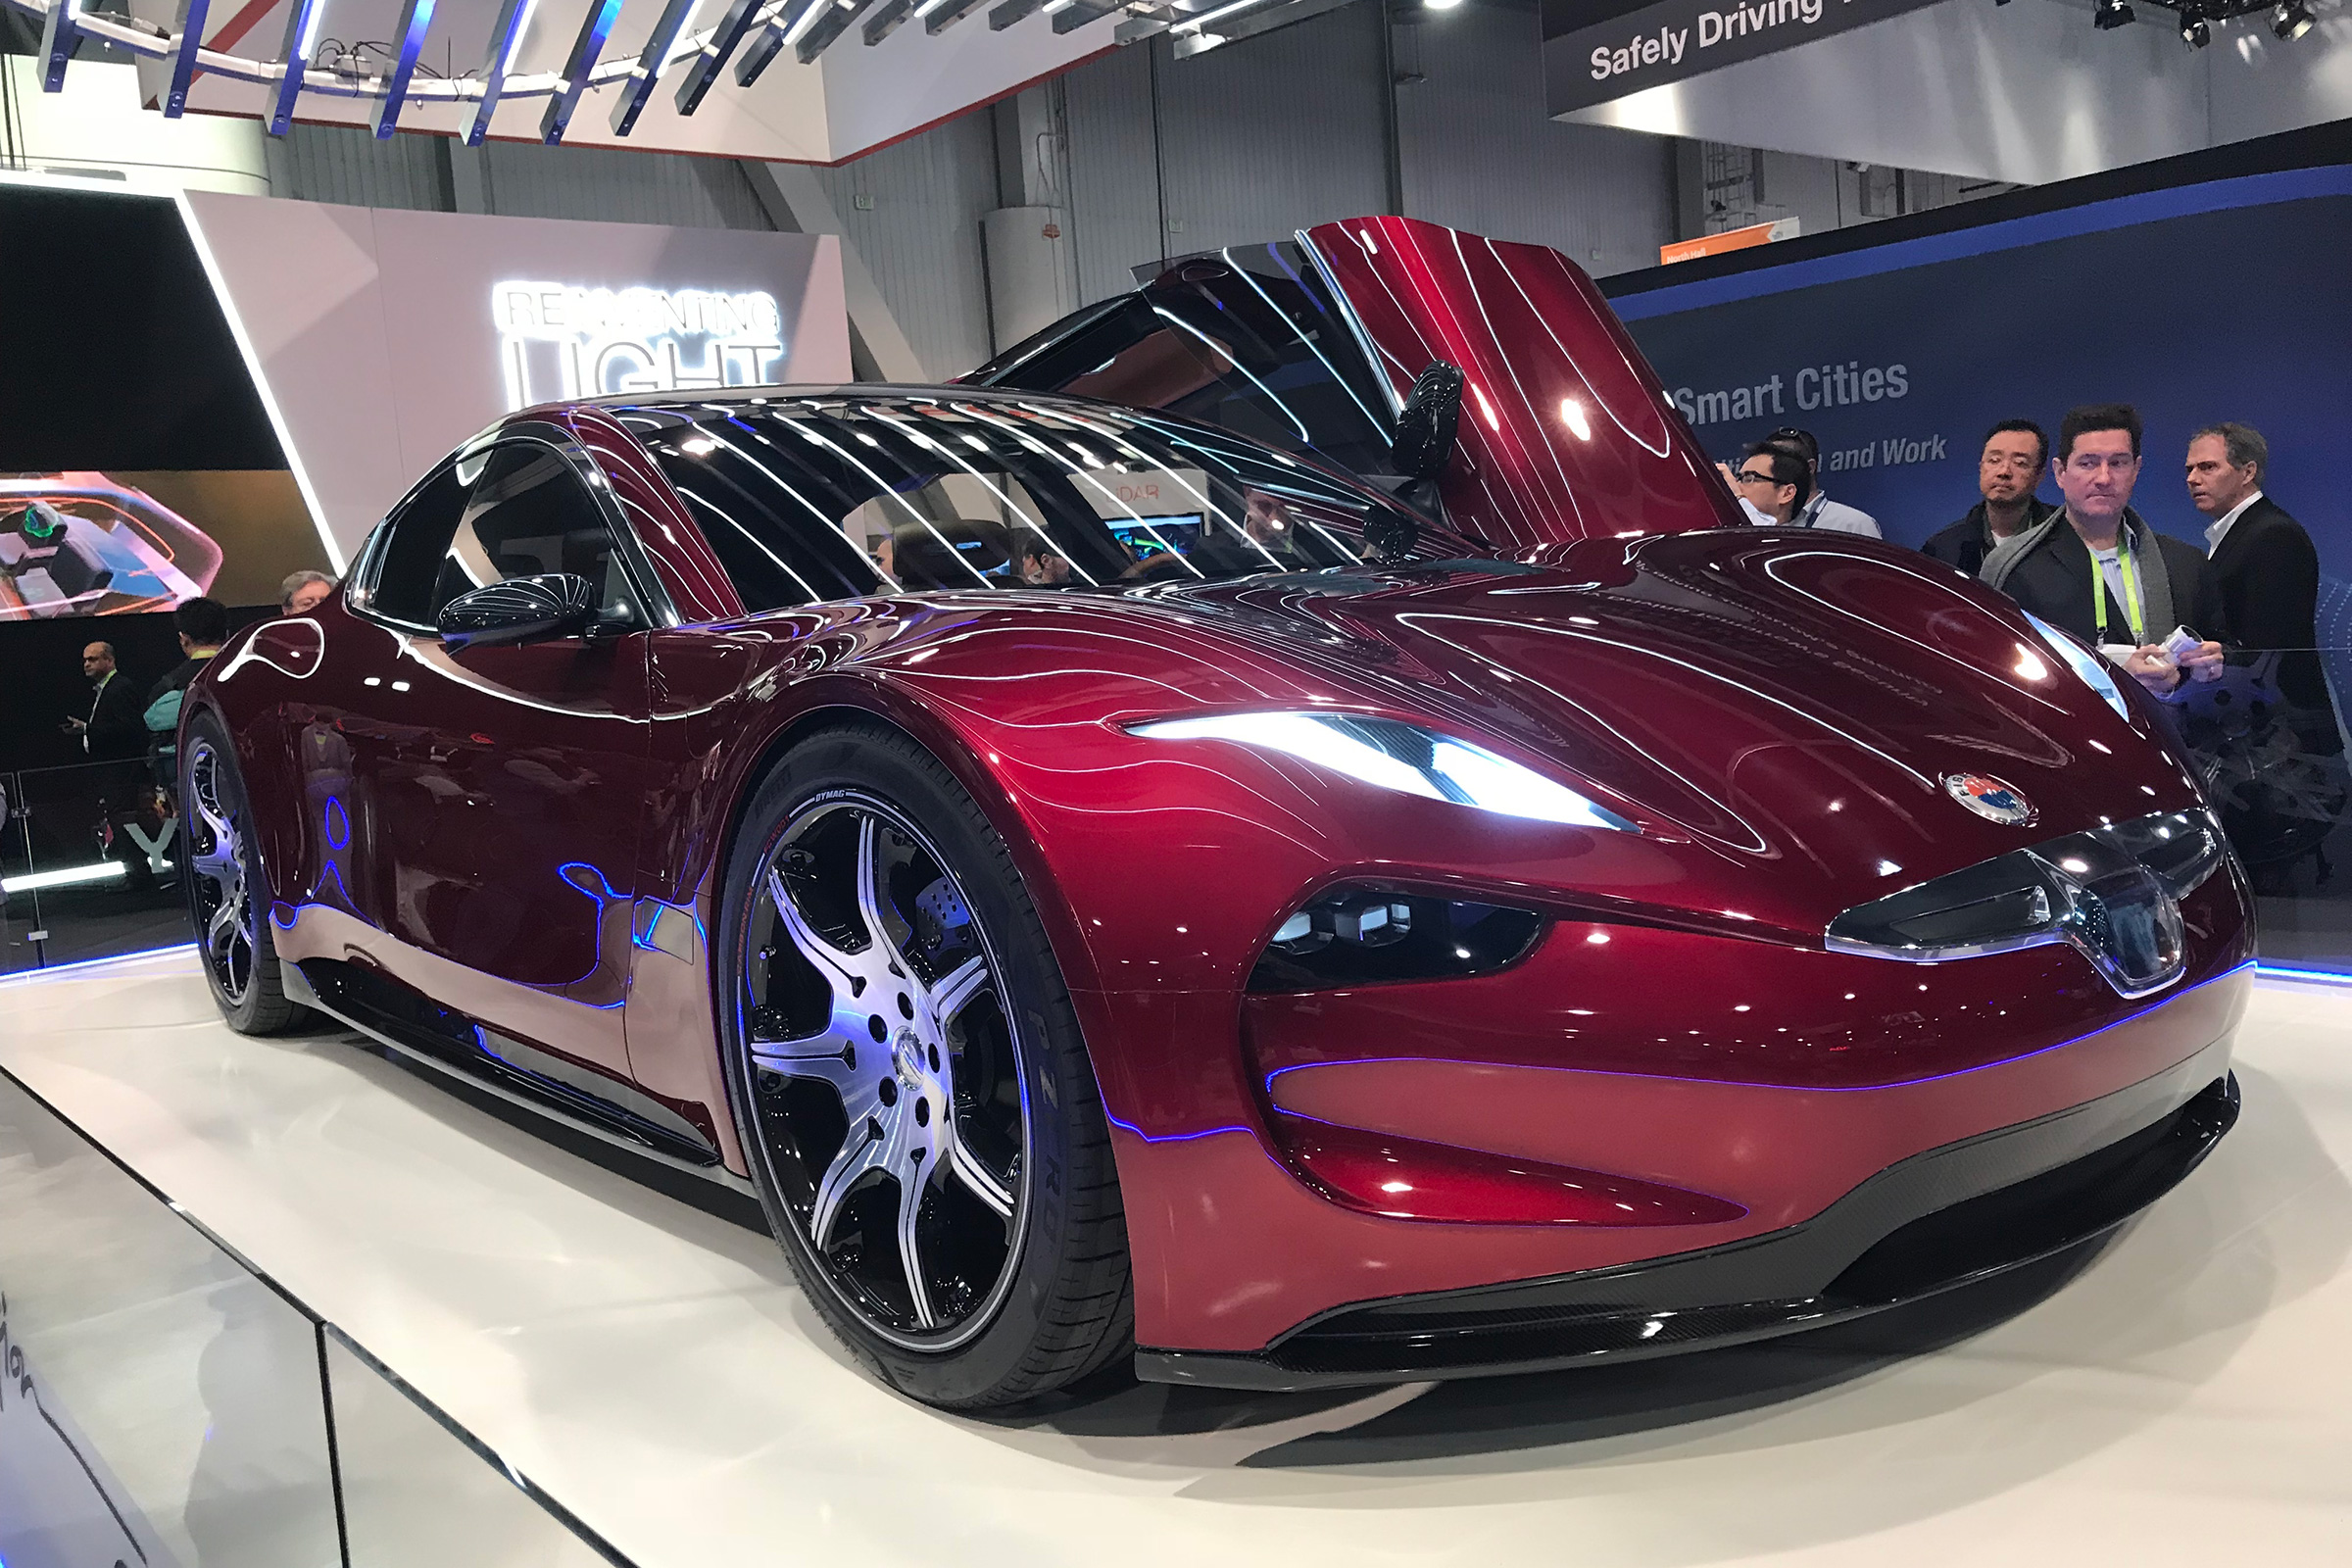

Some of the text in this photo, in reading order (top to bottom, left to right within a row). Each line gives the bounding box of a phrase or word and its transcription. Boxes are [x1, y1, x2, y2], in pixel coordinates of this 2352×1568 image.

[1590, 0, 1823, 80] Safely Driving
[1667, 247, 1706, 265] North Hall
[1674, 361, 1909, 425] Smart Cities
[1830, 441, 1877, 472] and
[1882, 434, 1948, 466] Work
[814, 789, 846, 803] DYMAG
[1039, 1065, 1060, 1244] ZRO
